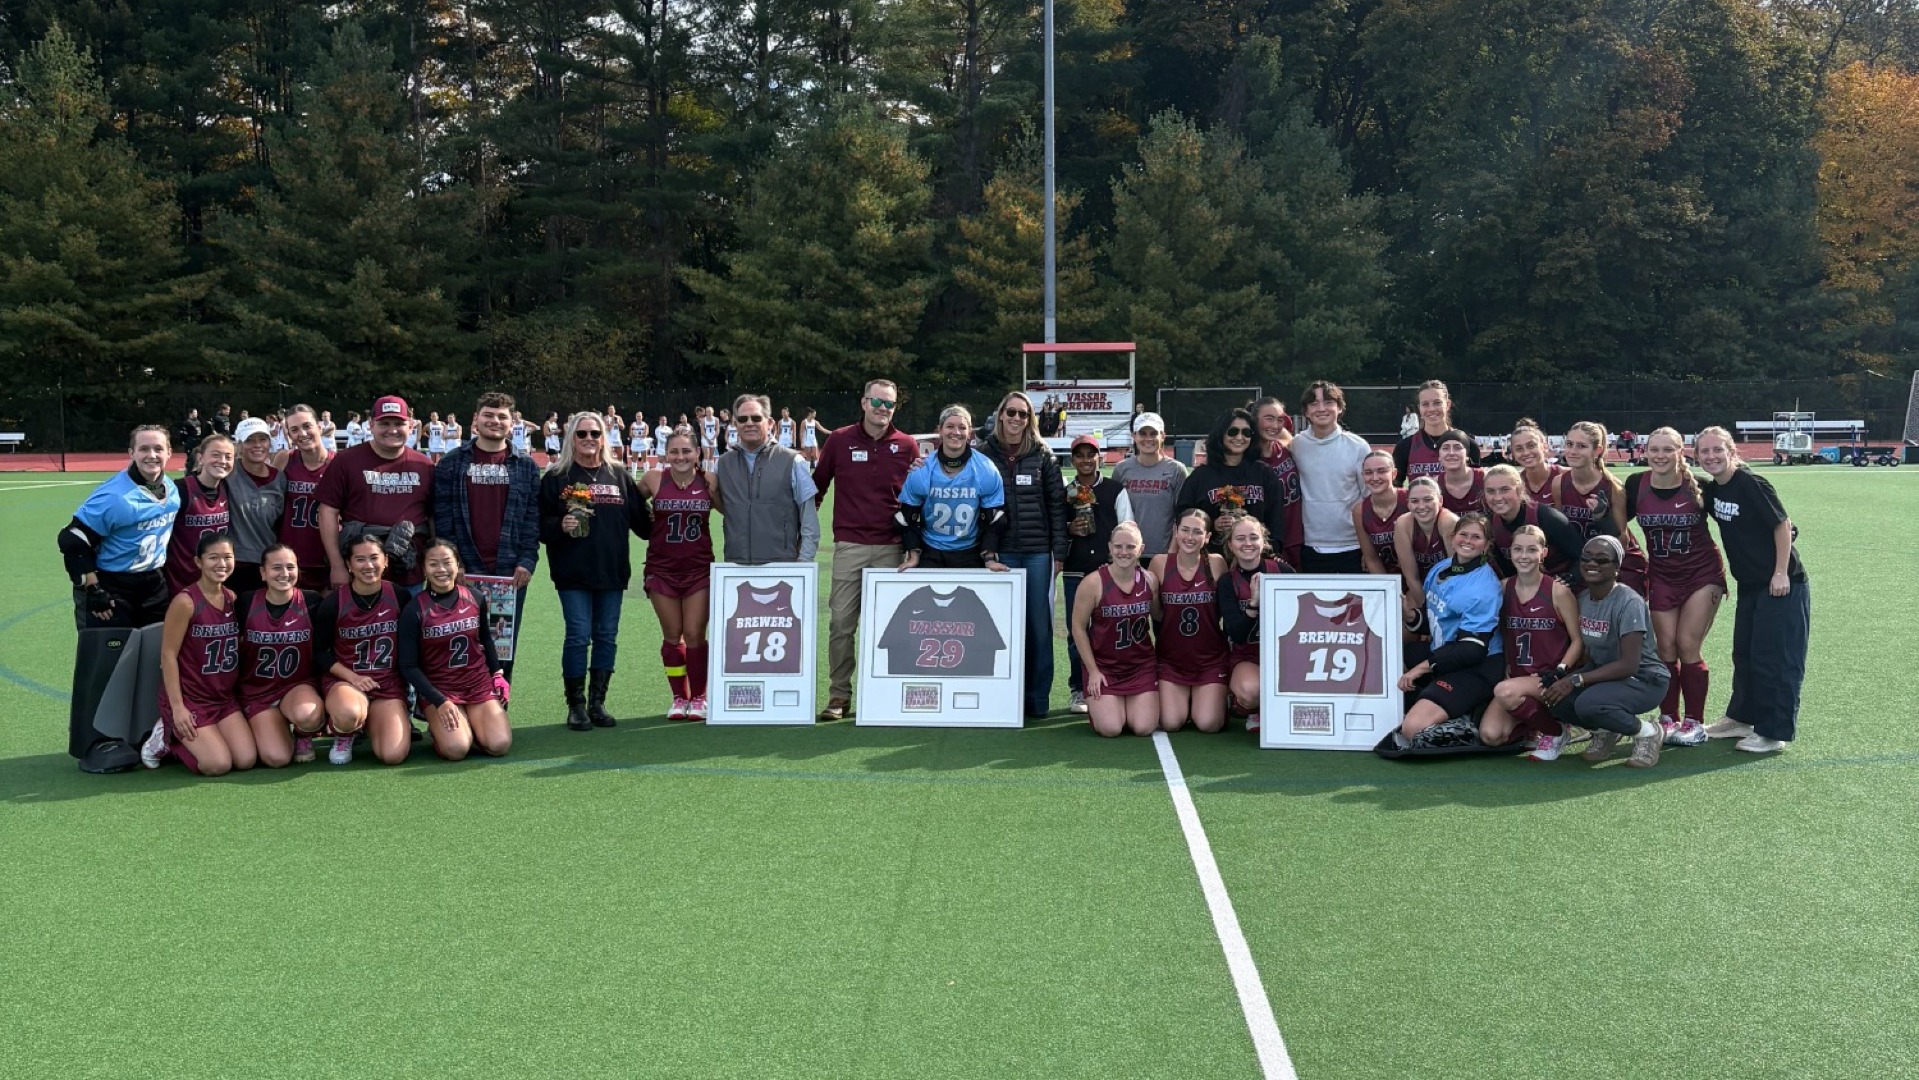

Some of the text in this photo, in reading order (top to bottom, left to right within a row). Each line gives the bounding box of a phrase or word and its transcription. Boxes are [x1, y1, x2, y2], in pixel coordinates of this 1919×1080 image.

[1063, 401, 1113, 411] BREWERS
[1066, 392, 1108, 402] VASSAR
[363, 470, 421, 486] VASSAR
[371, 485, 413, 494] BREWERS
[666, 513, 702, 543] 18
[933, 502, 974, 537] 29
[1650, 528, 1692, 558] 14
[735, 616, 793, 629] BREWERS
[908, 620, 976, 637] VASSAR
[1115, 616, 1147, 650] 10
[1179, 606, 1200, 637] 8
[246, 629, 311, 645] BREWERS
[449, 634, 469, 669] 2
[740, 631, 787, 663] 18
[1298, 631, 1365, 645] BREWERS
[1515, 631, 1534, 666] 1
[201, 636, 239, 675] 15
[255, 645, 300, 679] 20
[353, 636, 394, 672] 12
[915, 638, 965, 668] 29
[1305, 648, 1357, 682] 19
